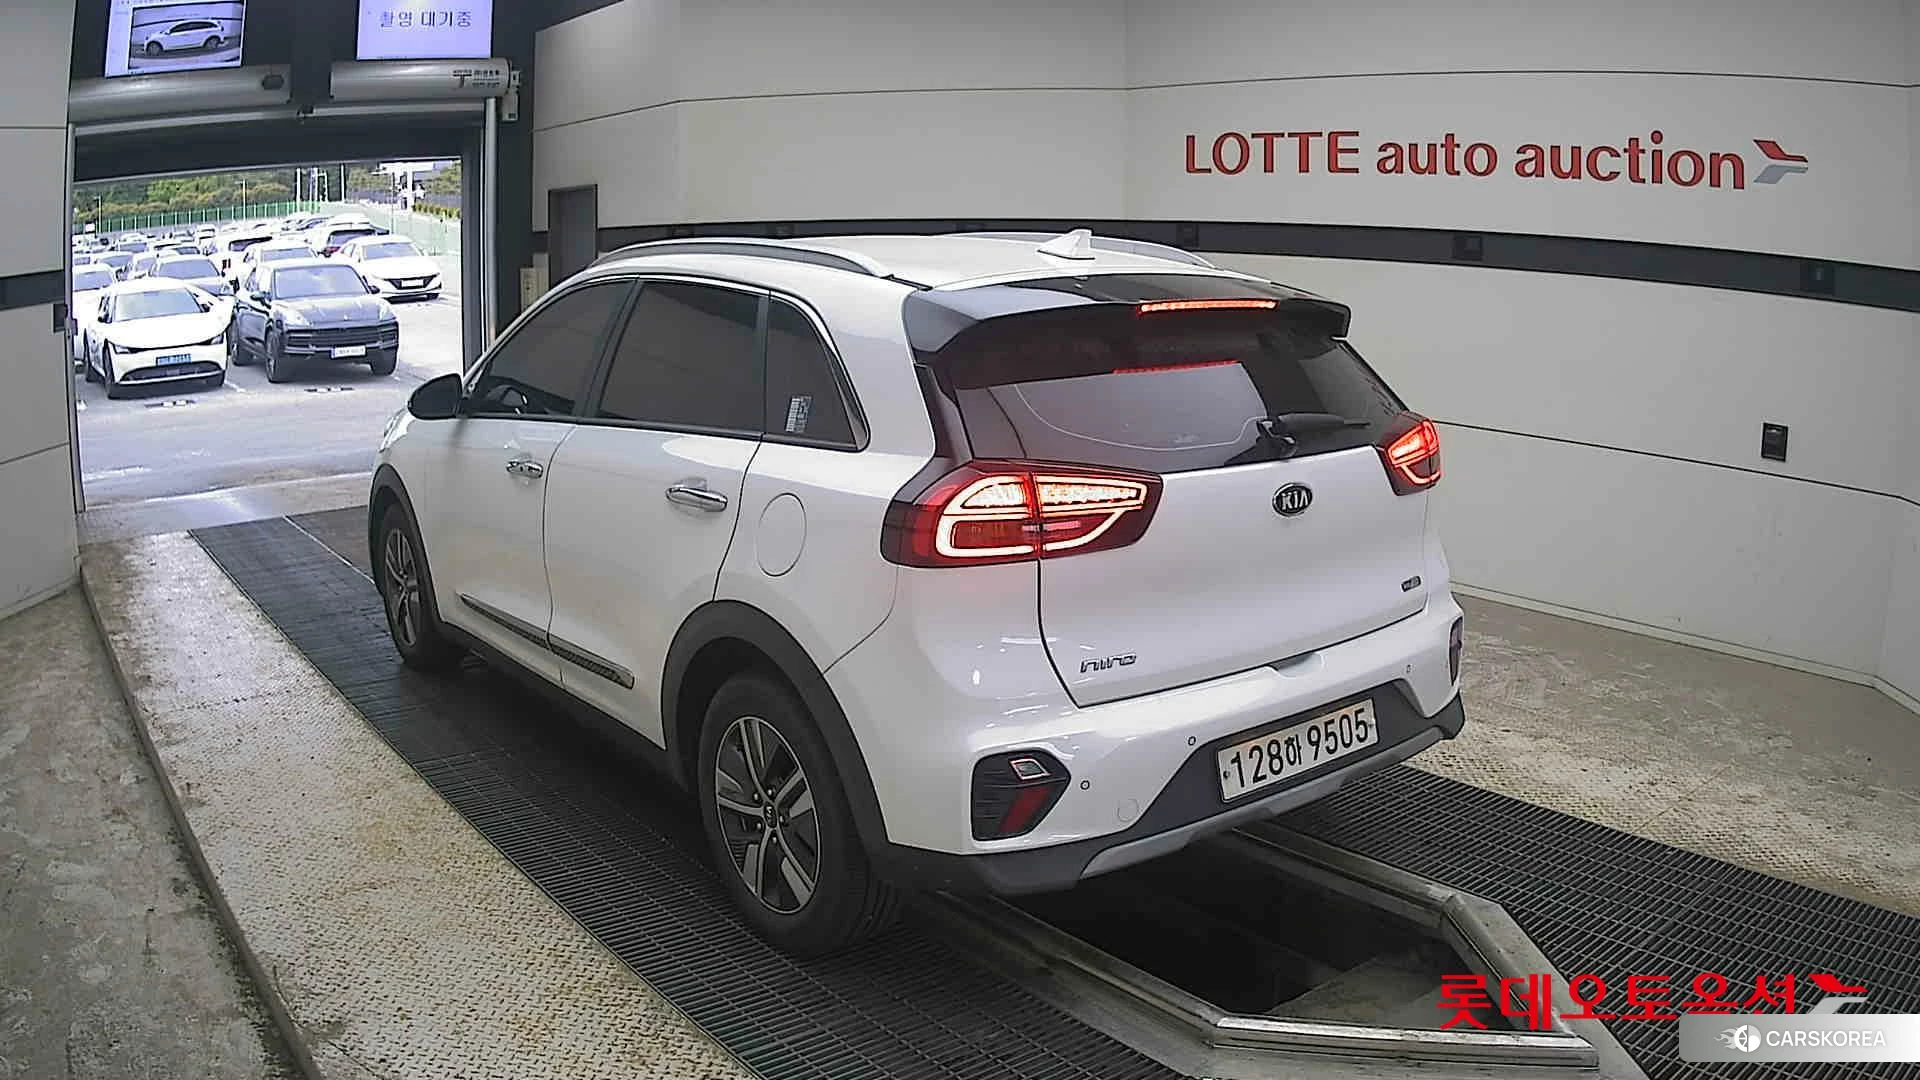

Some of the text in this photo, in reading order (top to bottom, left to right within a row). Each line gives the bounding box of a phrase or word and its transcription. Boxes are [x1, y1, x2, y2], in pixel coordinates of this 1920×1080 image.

[420, 10, 472, 28] 대기중
[1184, 130, 1746, 190] LOTTE auto auction
[1281, 489, 1309, 511] KIA
[1230, 707, 1369, 789] 128하 9505
